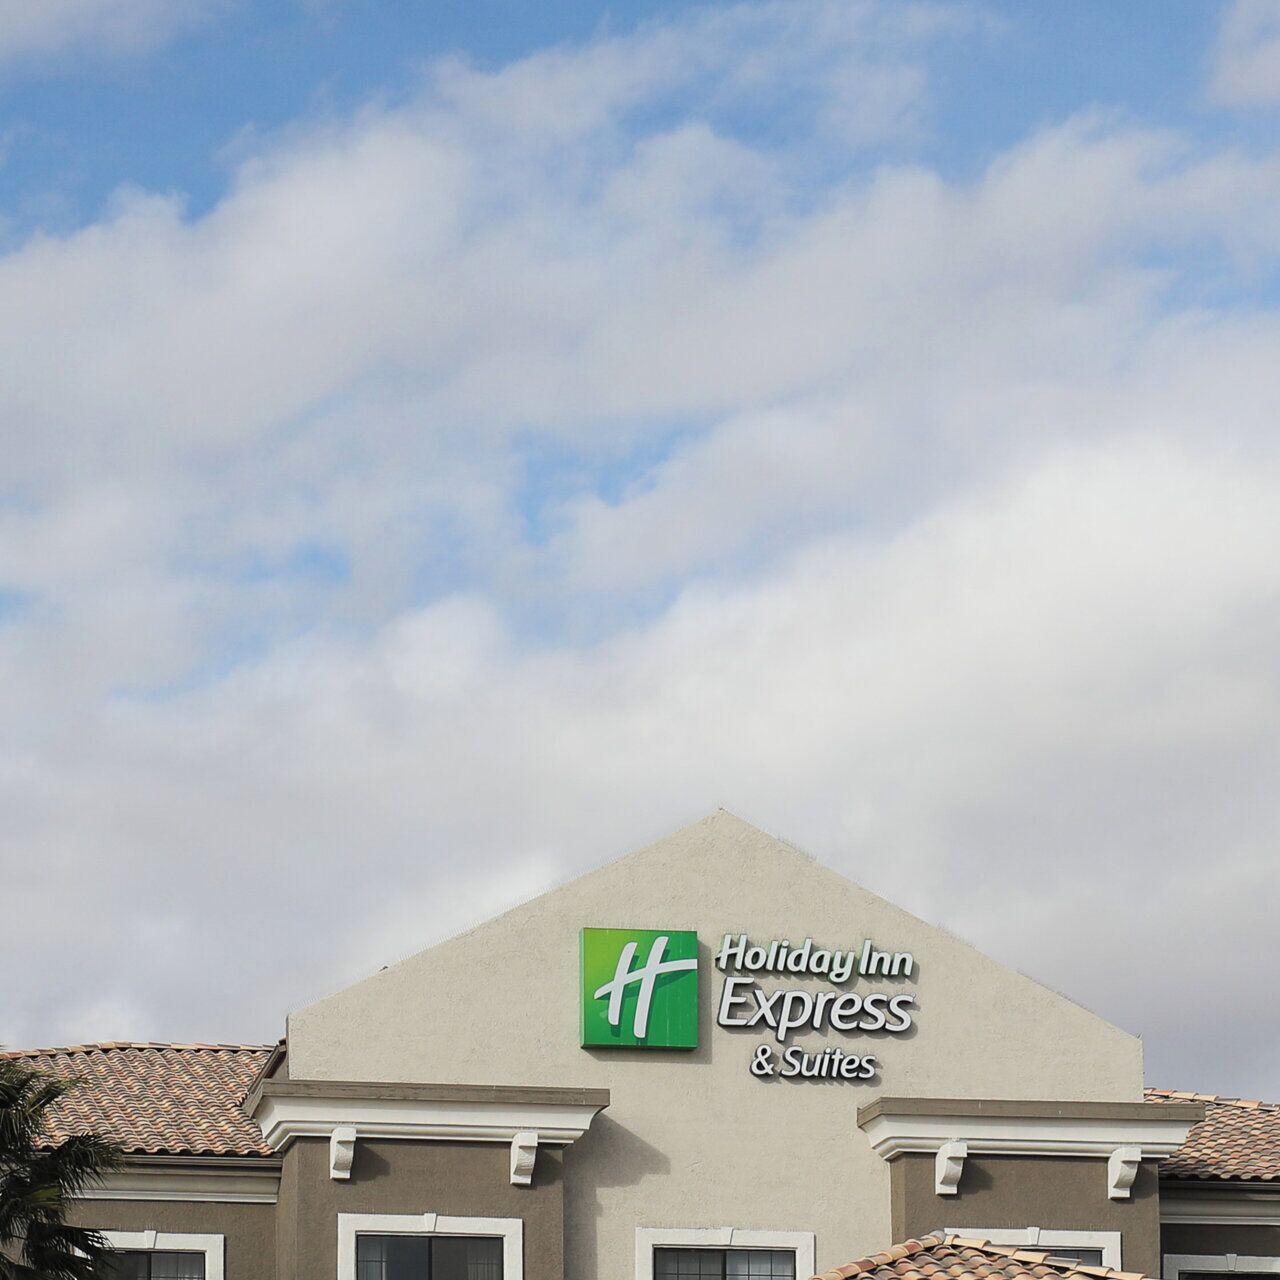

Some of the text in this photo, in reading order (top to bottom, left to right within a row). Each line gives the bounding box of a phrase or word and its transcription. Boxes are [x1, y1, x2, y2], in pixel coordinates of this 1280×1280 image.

[715, 933, 914, 983] Holiday Inn
[718, 976, 914, 1041] Express
[750, 1044, 877, 1079] & Suites
